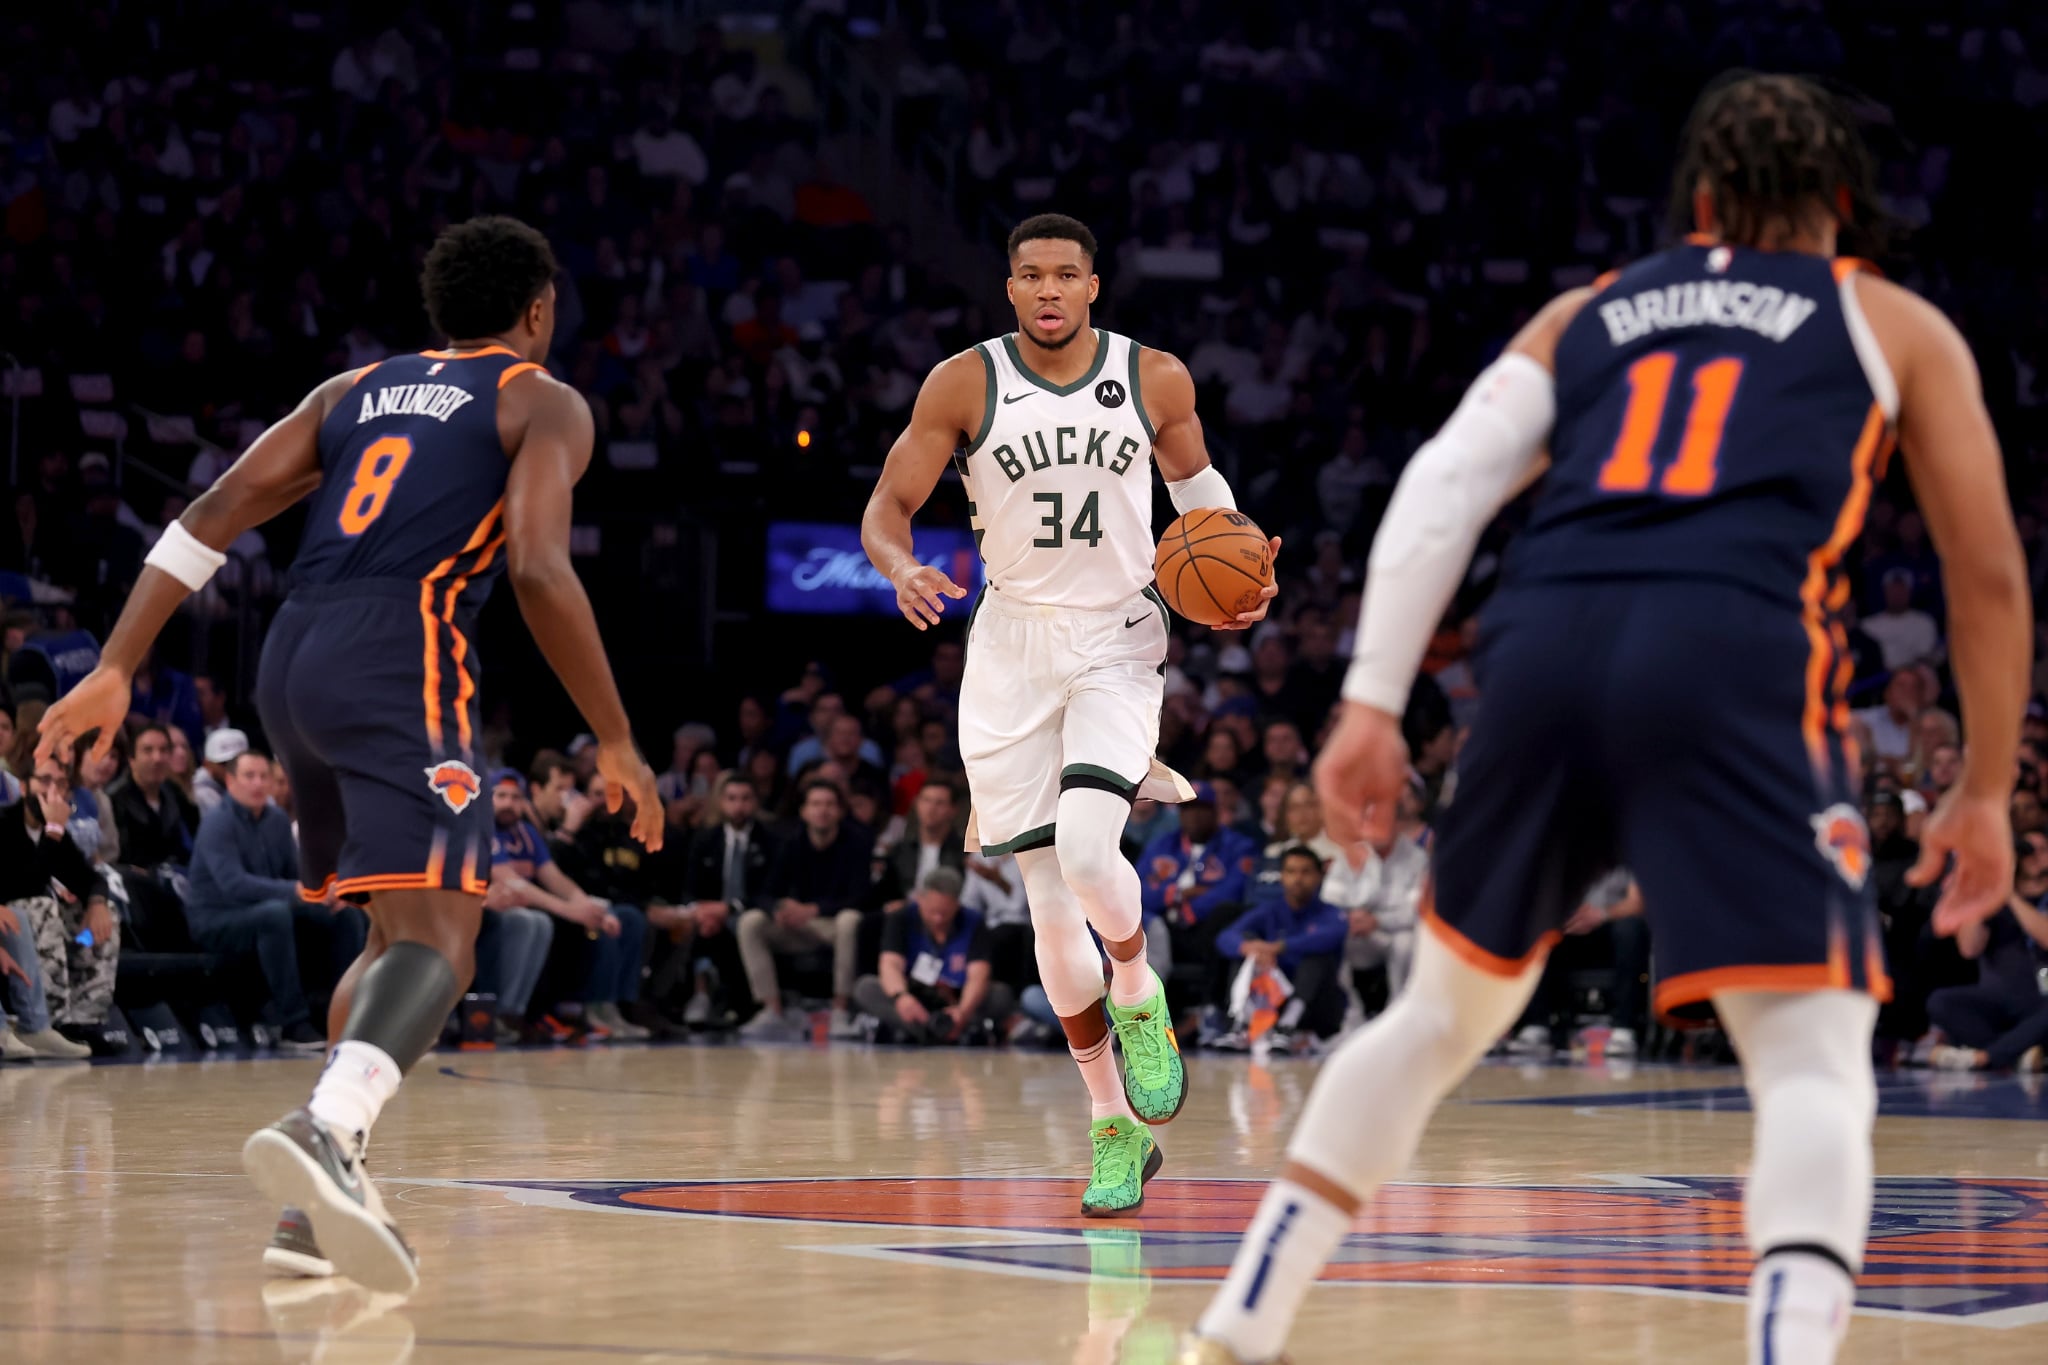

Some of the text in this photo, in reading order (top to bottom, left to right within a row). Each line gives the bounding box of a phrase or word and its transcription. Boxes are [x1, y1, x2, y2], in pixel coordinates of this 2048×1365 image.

[1598, 279, 1817, 347] BRUNSON
[356, 383, 475, 424] ANUNOBY
[1597, 350, 1745, 495] 11
[337, 433, 414, 536] 8
[992, 426, 1140, 483] BUCKS
[1032, 491, 1103, 548] 34
